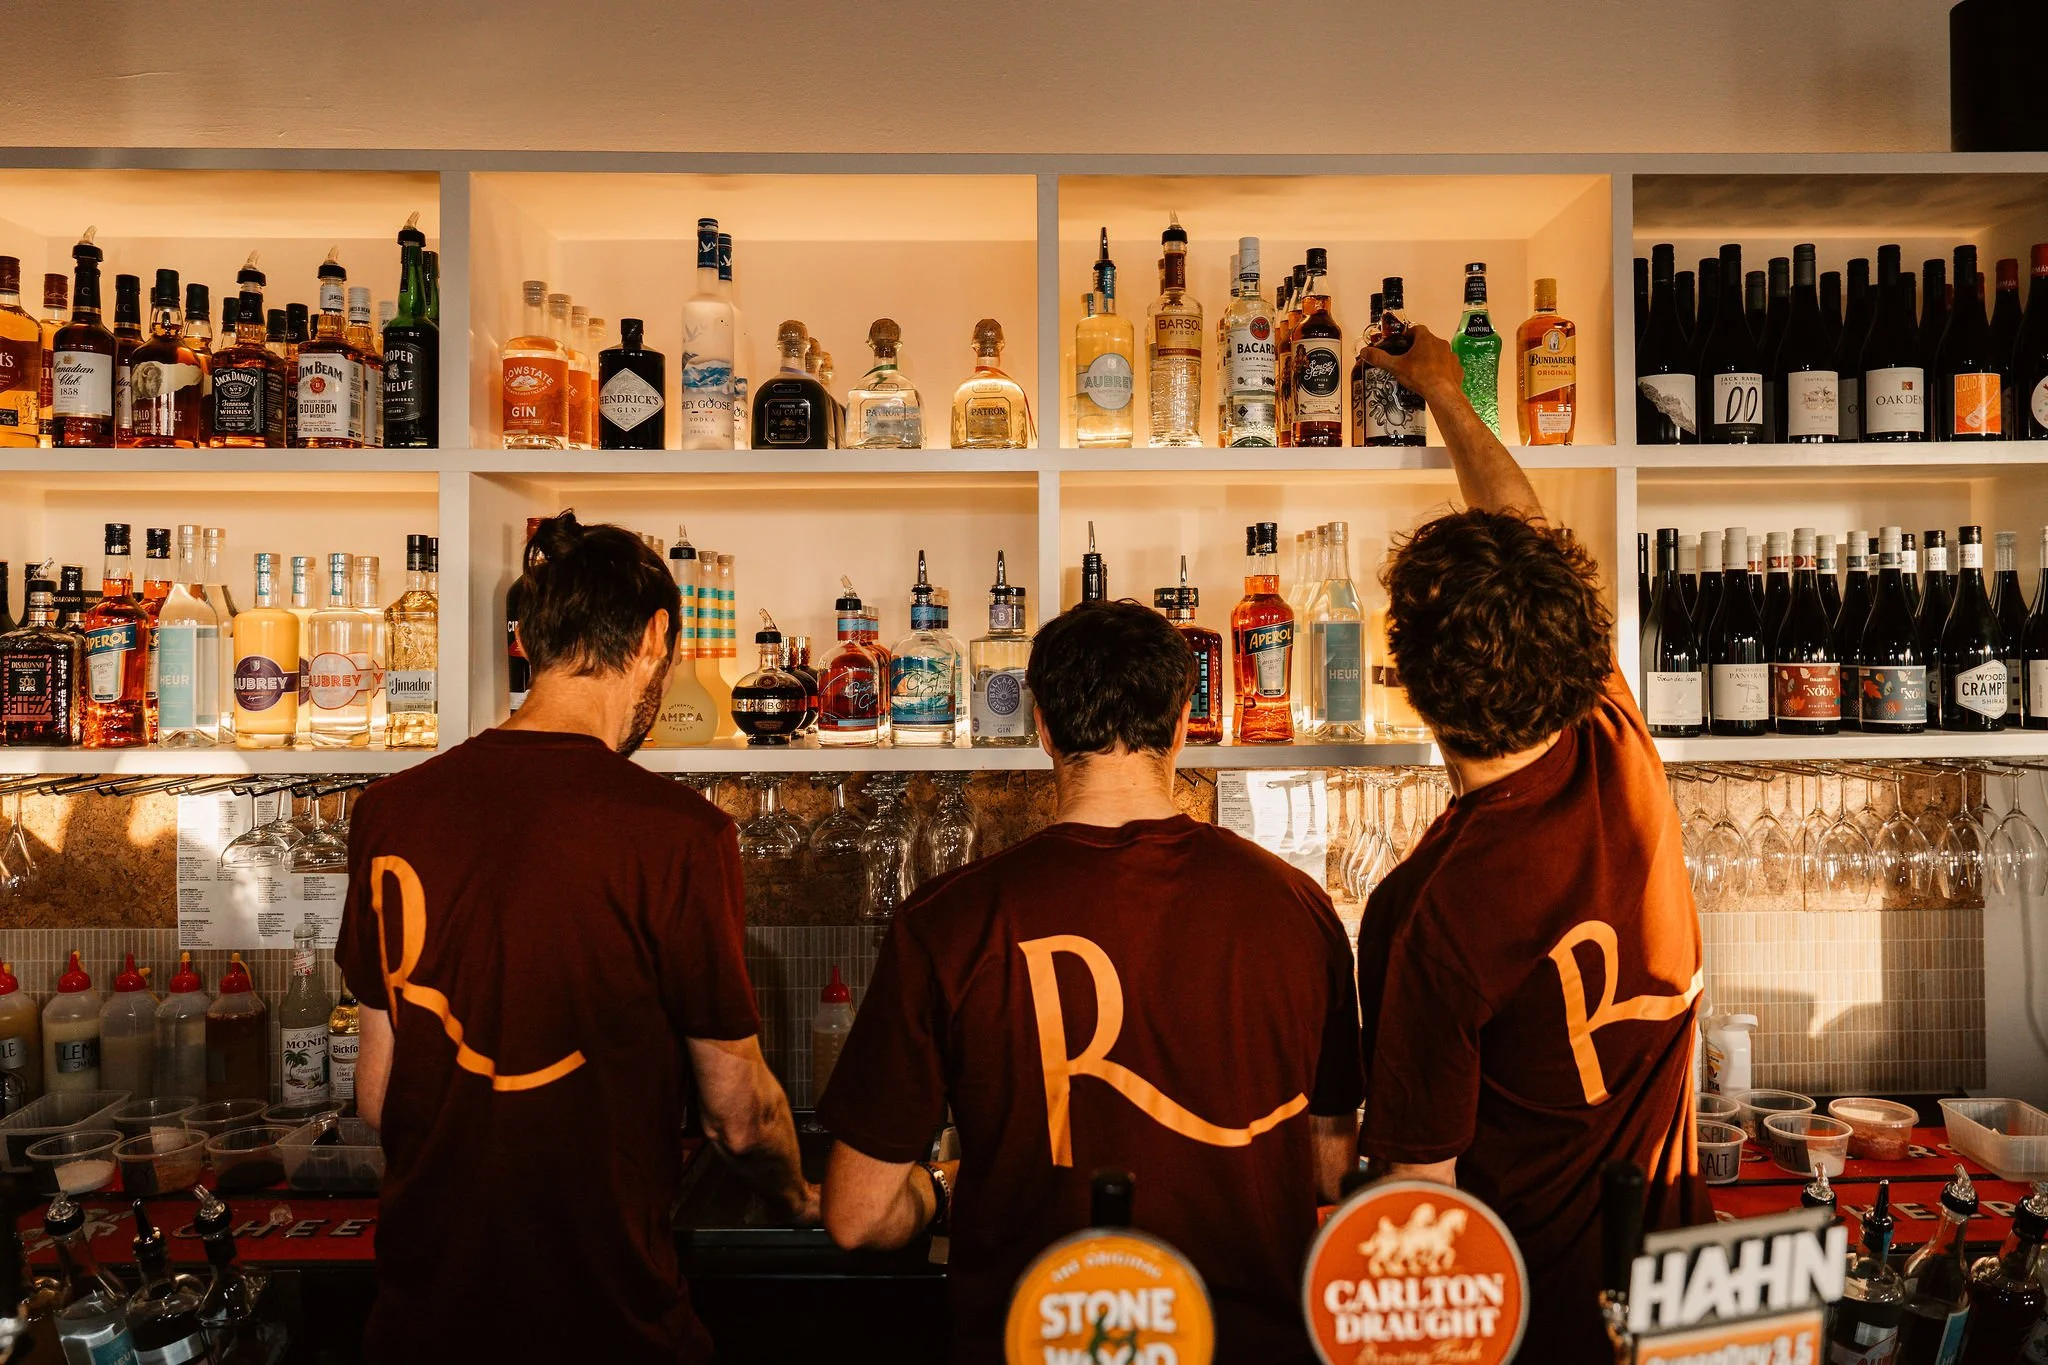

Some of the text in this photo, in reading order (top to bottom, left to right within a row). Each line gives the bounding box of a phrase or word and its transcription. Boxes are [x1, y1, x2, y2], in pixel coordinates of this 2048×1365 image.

[1158, 318, 1201, 331] BARSOL
[298, 361, 344, 383] JIM BEAM
[504, 366, 555, 386] LOWSTATE
[214, 371, 259, 387] JACK DANIEL'S
[59, 388, 79, 396] 1858
[600, 394, 660, 406] HENDRICK'S
[682, 398, 732, 411] REY GOOSE
[299, 403, 337, 414] BOURBON
[511, 406, 537, 418] GIN
[997, 612, 1006, 622] B
[1249, 628, 1292, 650] APEROL
[11, 661, 45, 669] DISARONNO
[308, 674, 362, 687] AUBREY
[1328, 669, 1359, 680] HEUR
[390, 676, 433, 696] Jimador
[1806, 687, 1835, 697] NOOK
[1962, 682, 2007, 696] CRAMPT
[991, 700, 1017, 713] SPIRITS
[286, 1036, 328, 1049] MONIN
[333, 1044, 358, 1054] Bickfo
[1016, 934, 1309, 1168] R
[1084, 1250, 1163, 1280] ORIGINAL
[1627, 1225, 1849, 1334] HAHN
[1322, 1272, 1506, 1316] CARLTON
[1038, 1287, 1178, 1340] STONE
[1334, 1305, 1502, 1345] DRAUGHT
